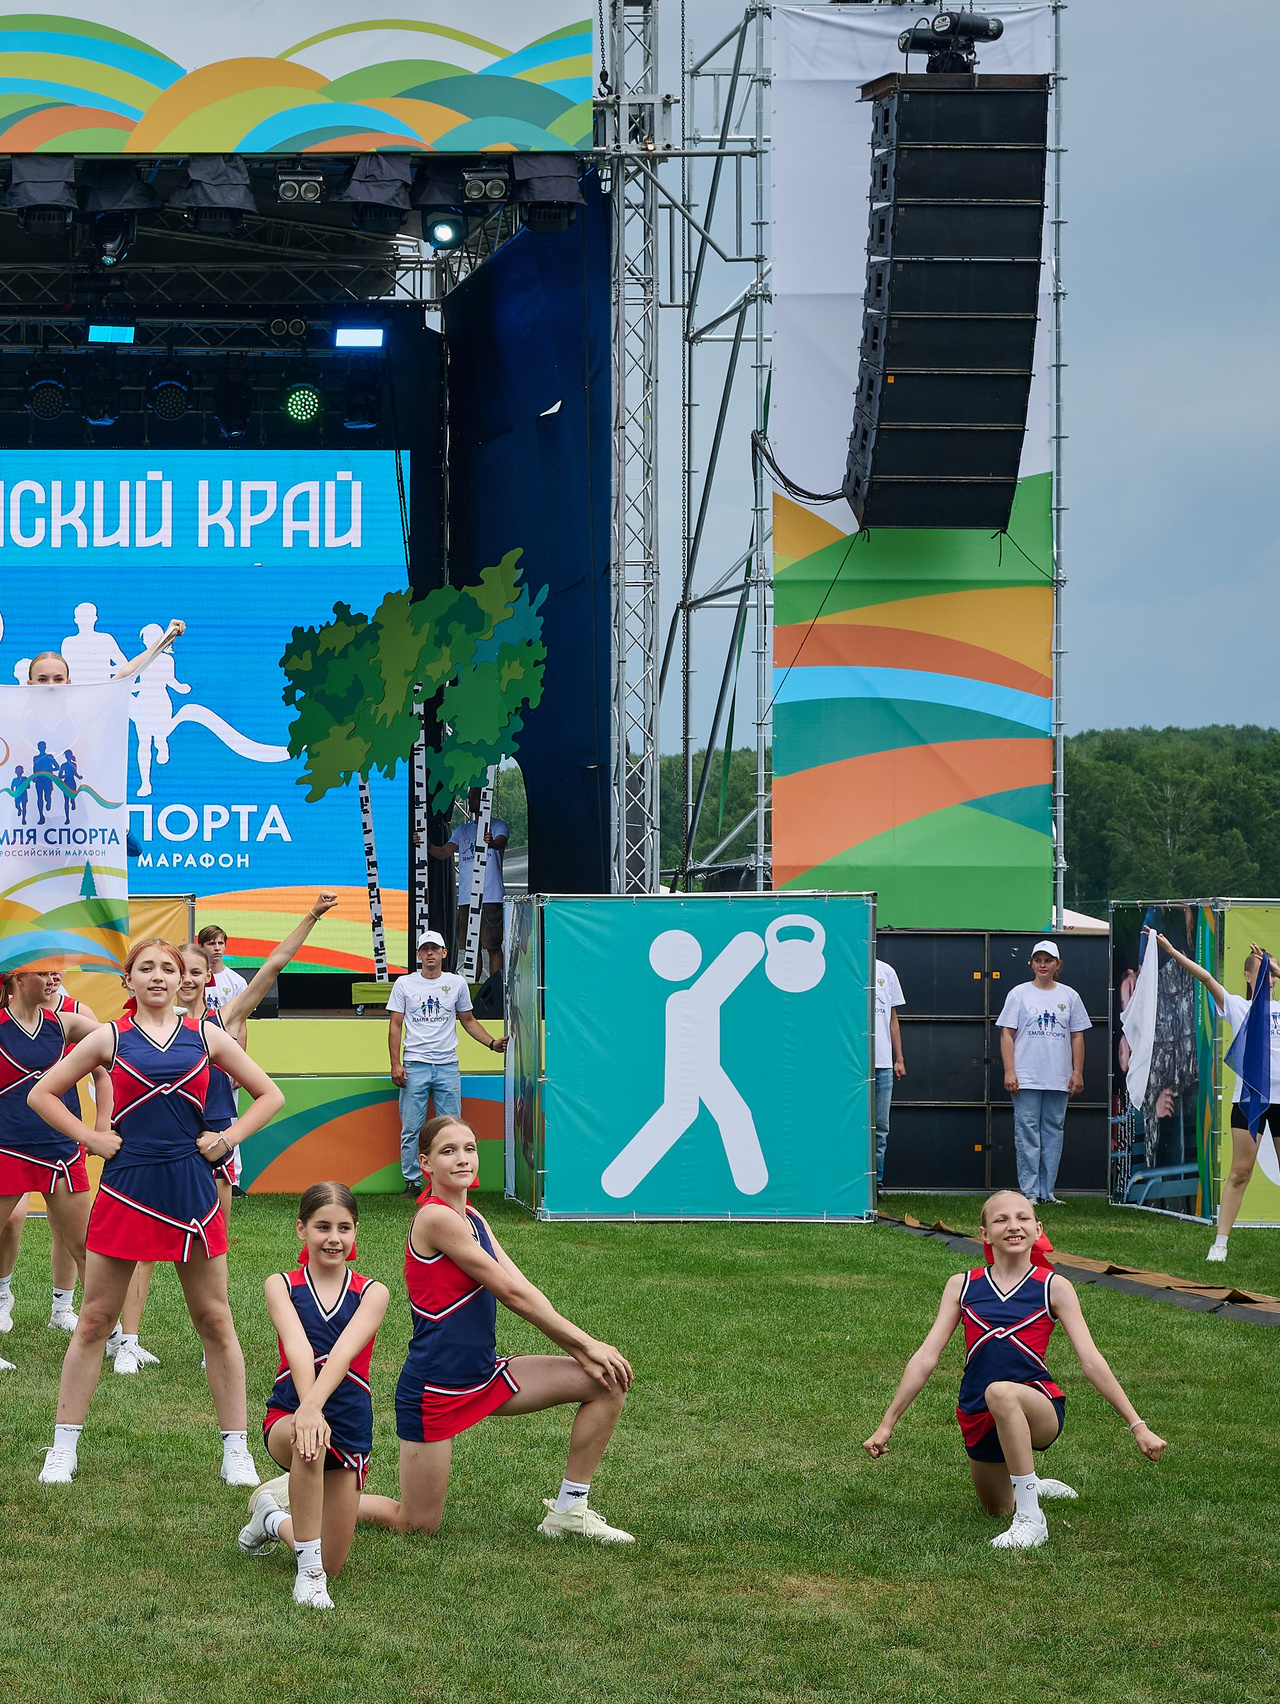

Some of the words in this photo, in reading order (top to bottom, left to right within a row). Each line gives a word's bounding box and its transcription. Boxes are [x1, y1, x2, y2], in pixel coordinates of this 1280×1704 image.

[198, 470, 363, 548] КРАЙ
[126, 804, 293, 842] ПОРТА
[43, 828, 120, 846] СПОРТА
[65, 849, 106, 857] МАРАФОН
[137, 852, 251, 868] МАРАФОН
